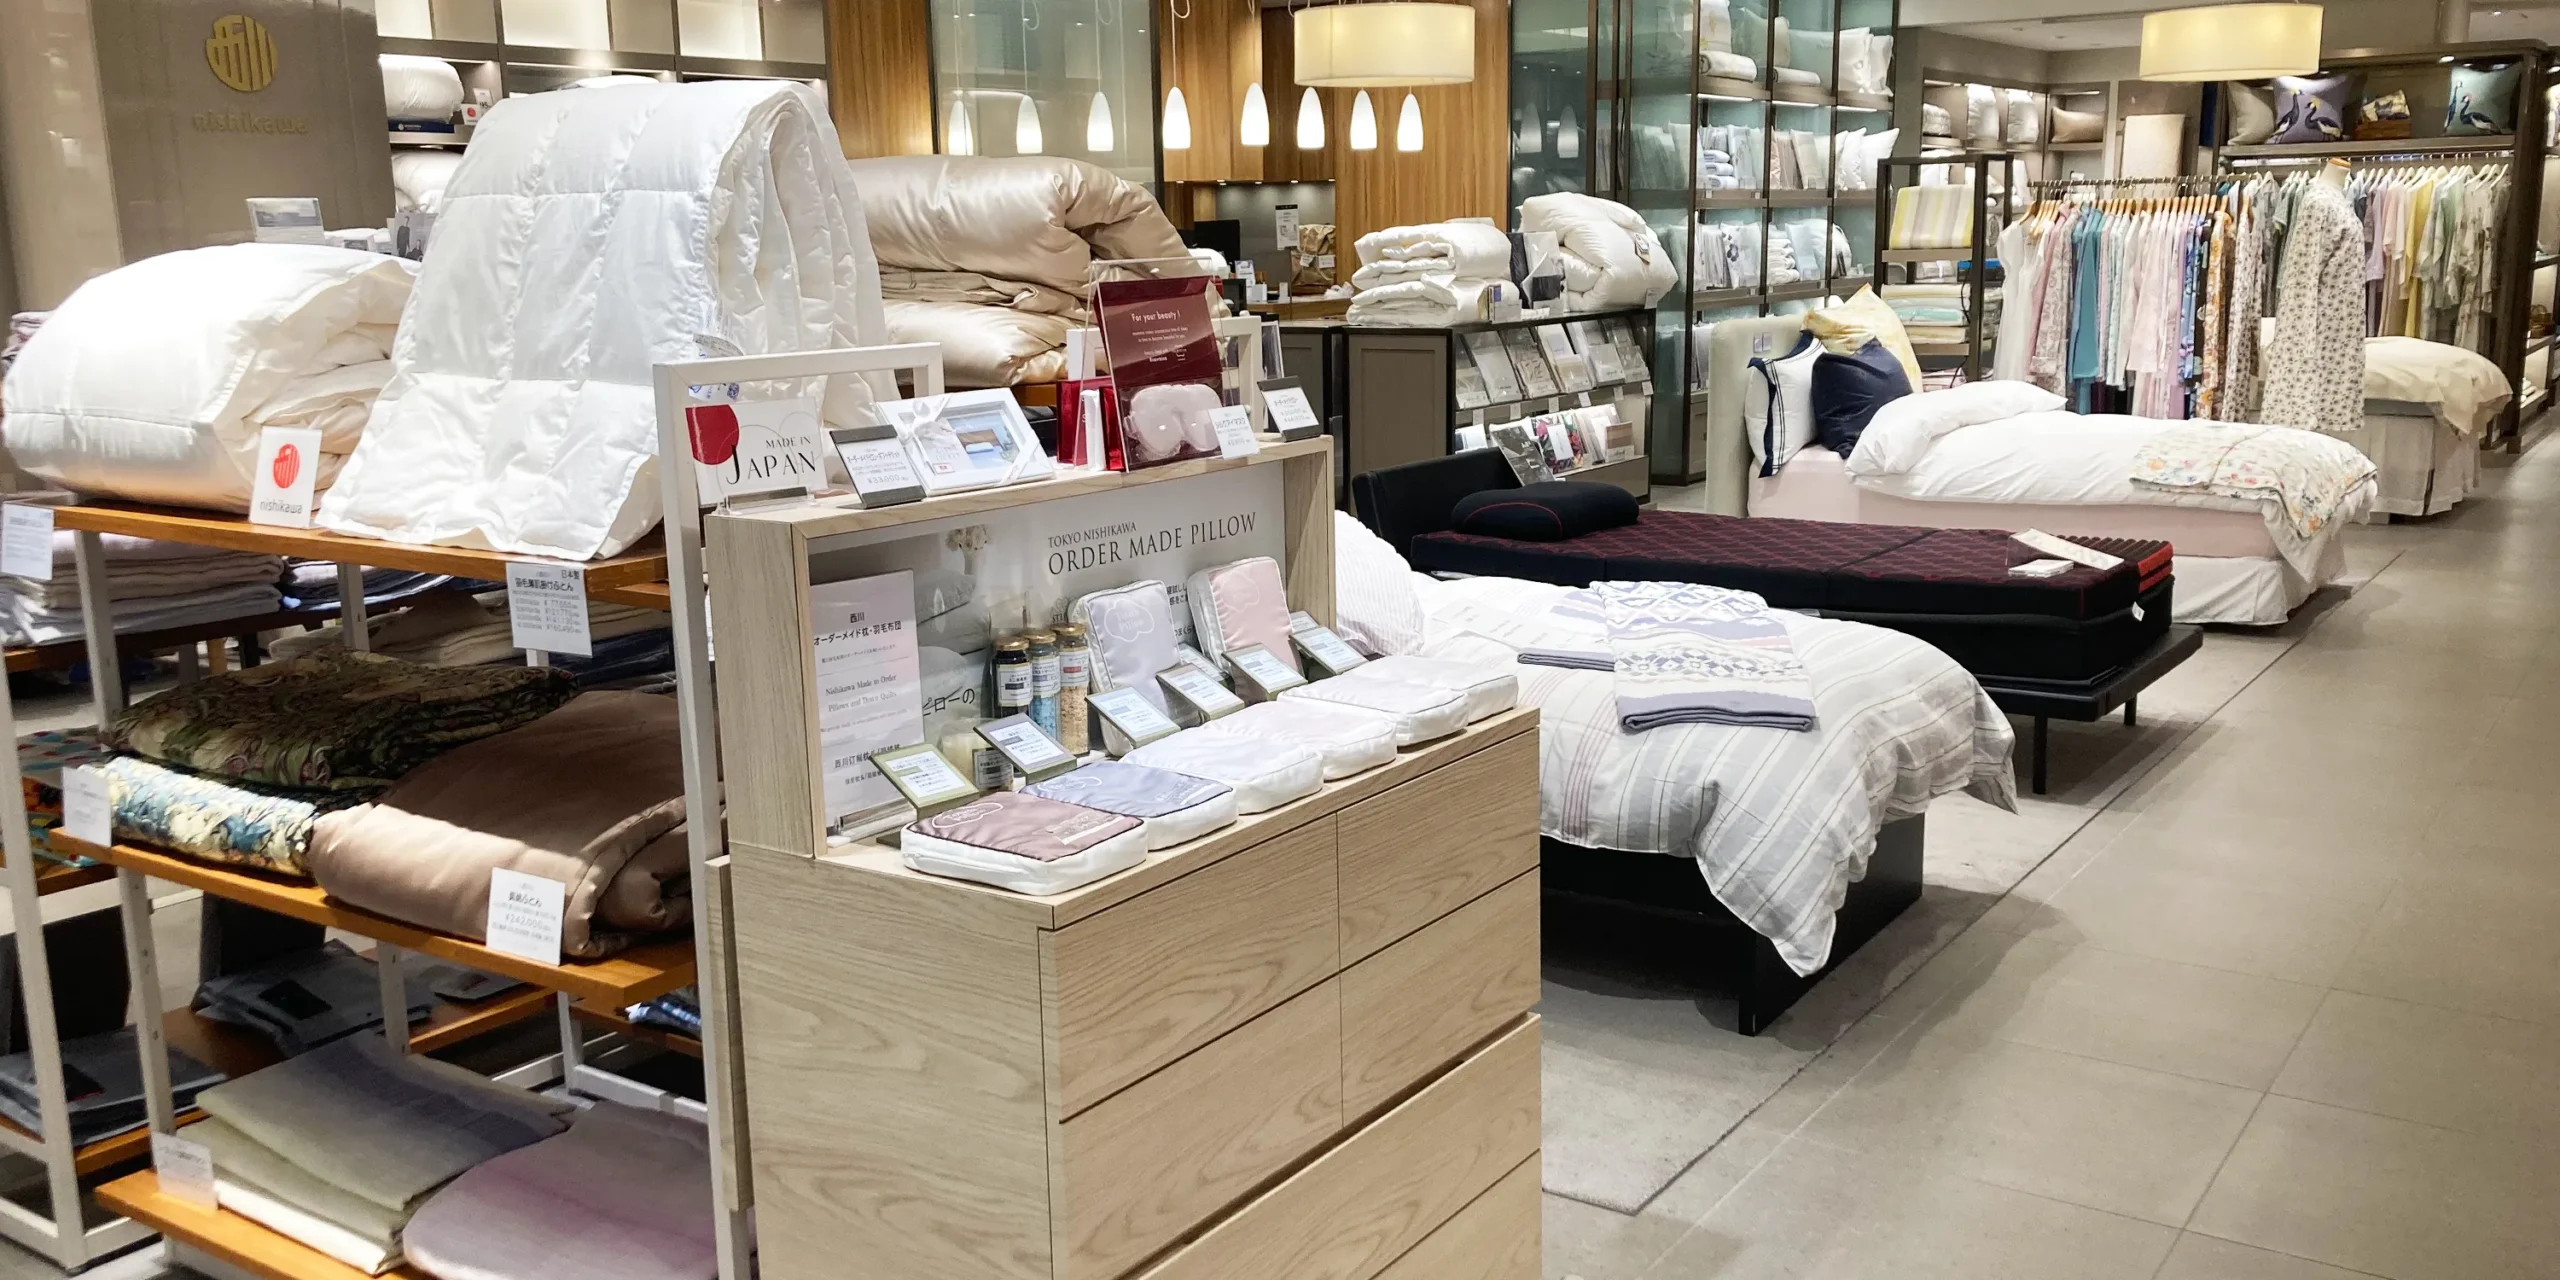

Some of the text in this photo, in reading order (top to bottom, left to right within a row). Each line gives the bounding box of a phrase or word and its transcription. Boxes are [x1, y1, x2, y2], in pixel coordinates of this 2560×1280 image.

[192, 105, 309, 134] nishikawa
[1131, 313, 1142, 322] For
[1143, 313, 1156, 323] your
[1156, 310, 1177, 320] beauty
[766, 435, 811, 449] MADE IN
[726, 445, 816, 485] JAPAN
[260, 499, 303, 514] nishikawa
[1048, 521, 1137, 549] TOKYO NISHIKAWA
[1048, 512, 1256, 575] ORDER MADE PILLOW
[850, 612, 864, 623] 西川
[813, 621, 901, 646] オーダーメイド枕・羽毛布団
[826, 684, 856, 696] Nishikawa
[857, 680, 872, 689] Made
[881, 675, 896, 684] Order
